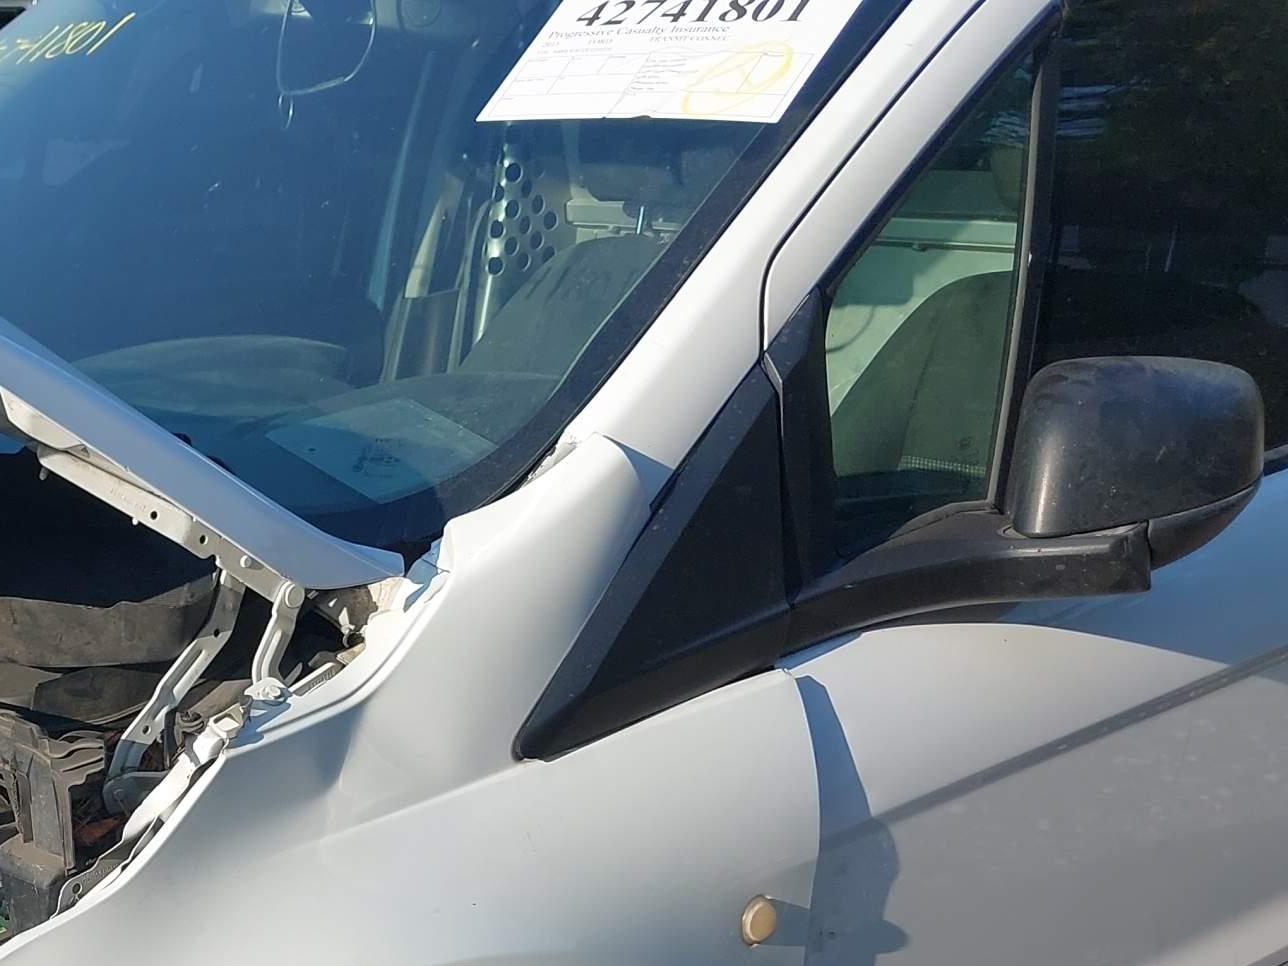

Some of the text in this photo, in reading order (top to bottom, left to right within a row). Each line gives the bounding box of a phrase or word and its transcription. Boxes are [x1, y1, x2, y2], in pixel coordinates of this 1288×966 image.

[576, 0, 811, 26] 42741801
[616, 25, 664, 36] Casualty
[671, 24, 730, 34] Insurance
